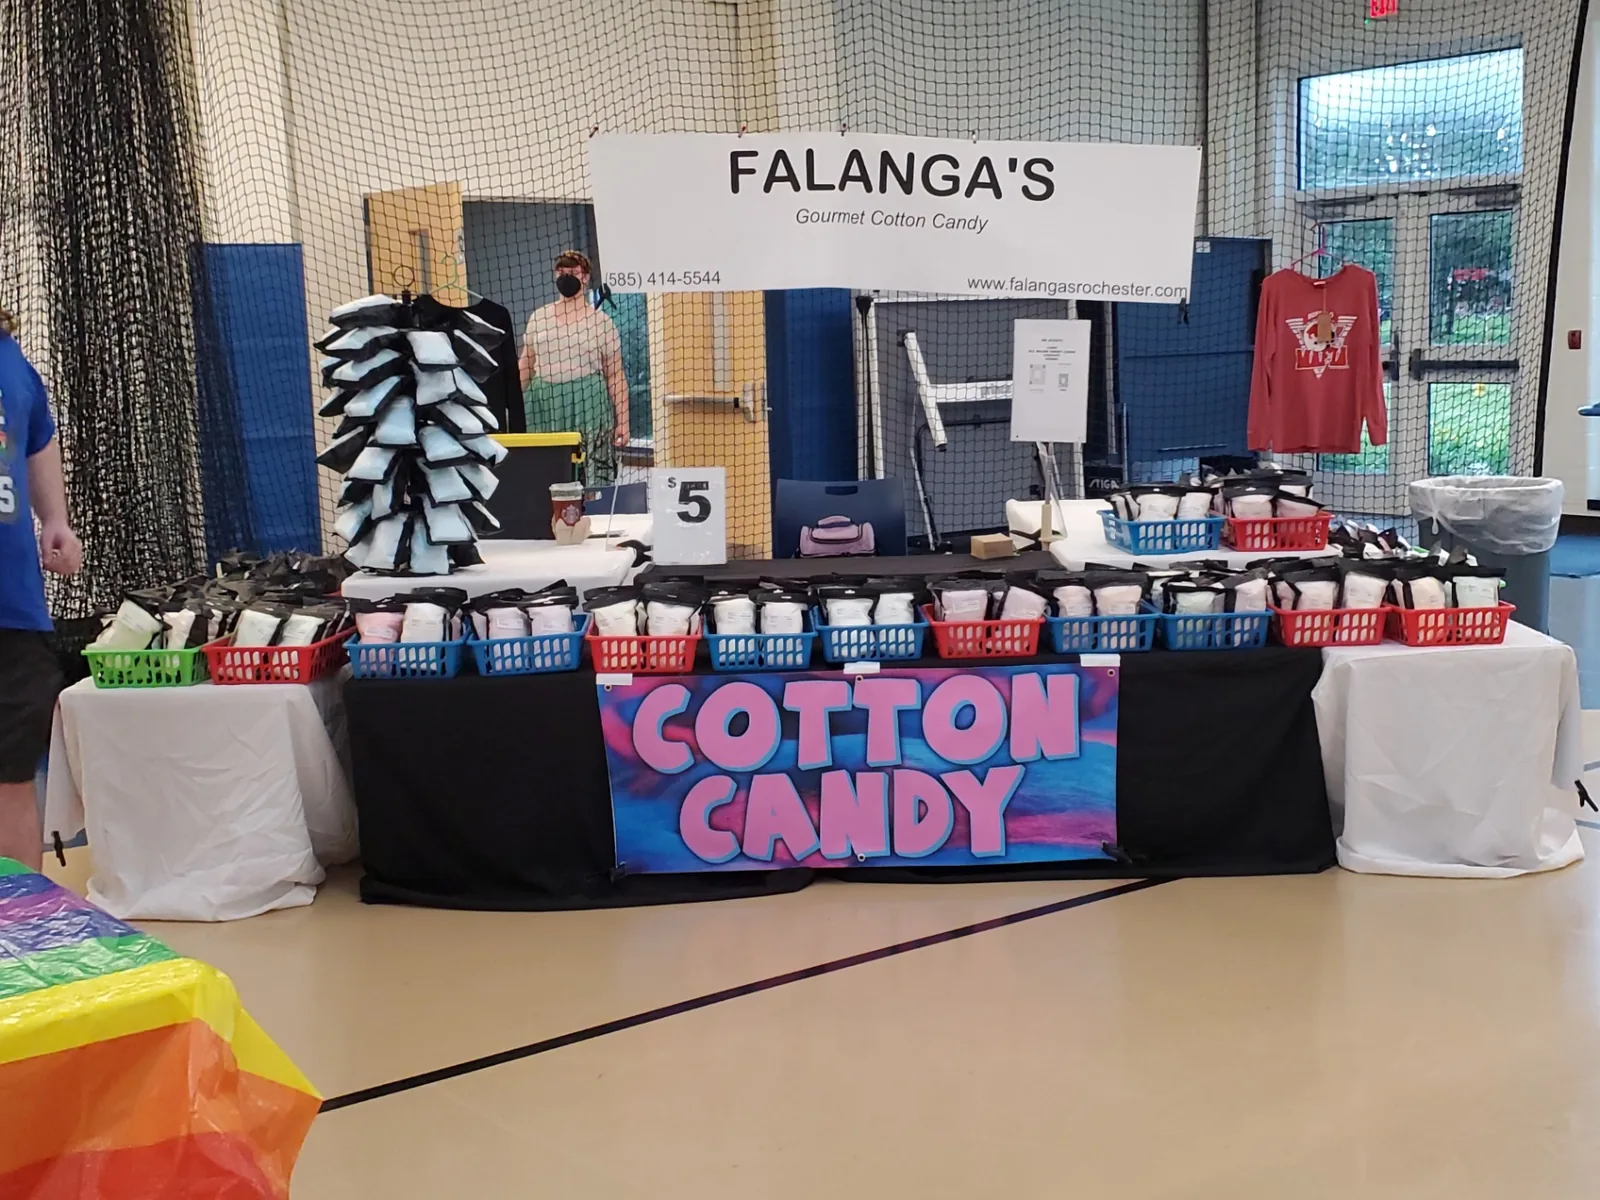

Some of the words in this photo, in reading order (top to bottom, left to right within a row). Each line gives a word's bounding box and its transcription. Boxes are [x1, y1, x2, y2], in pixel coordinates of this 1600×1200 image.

[729, 147, 1055, 201] FALANGA'S
[795, 208, 866, 225] Gourmet
[870, 209, 926, 228] Cotton
[932, 213, 989, 235] Candy
[604, 271, 643, 289] (585)
[647, 270, 721, 286] 414-5544
[967, 276, 1188, 299] www.falangasrochester.com
[632, 672, 1080, 774] COTTON
[679, 764, 1026, 864] CANDY
